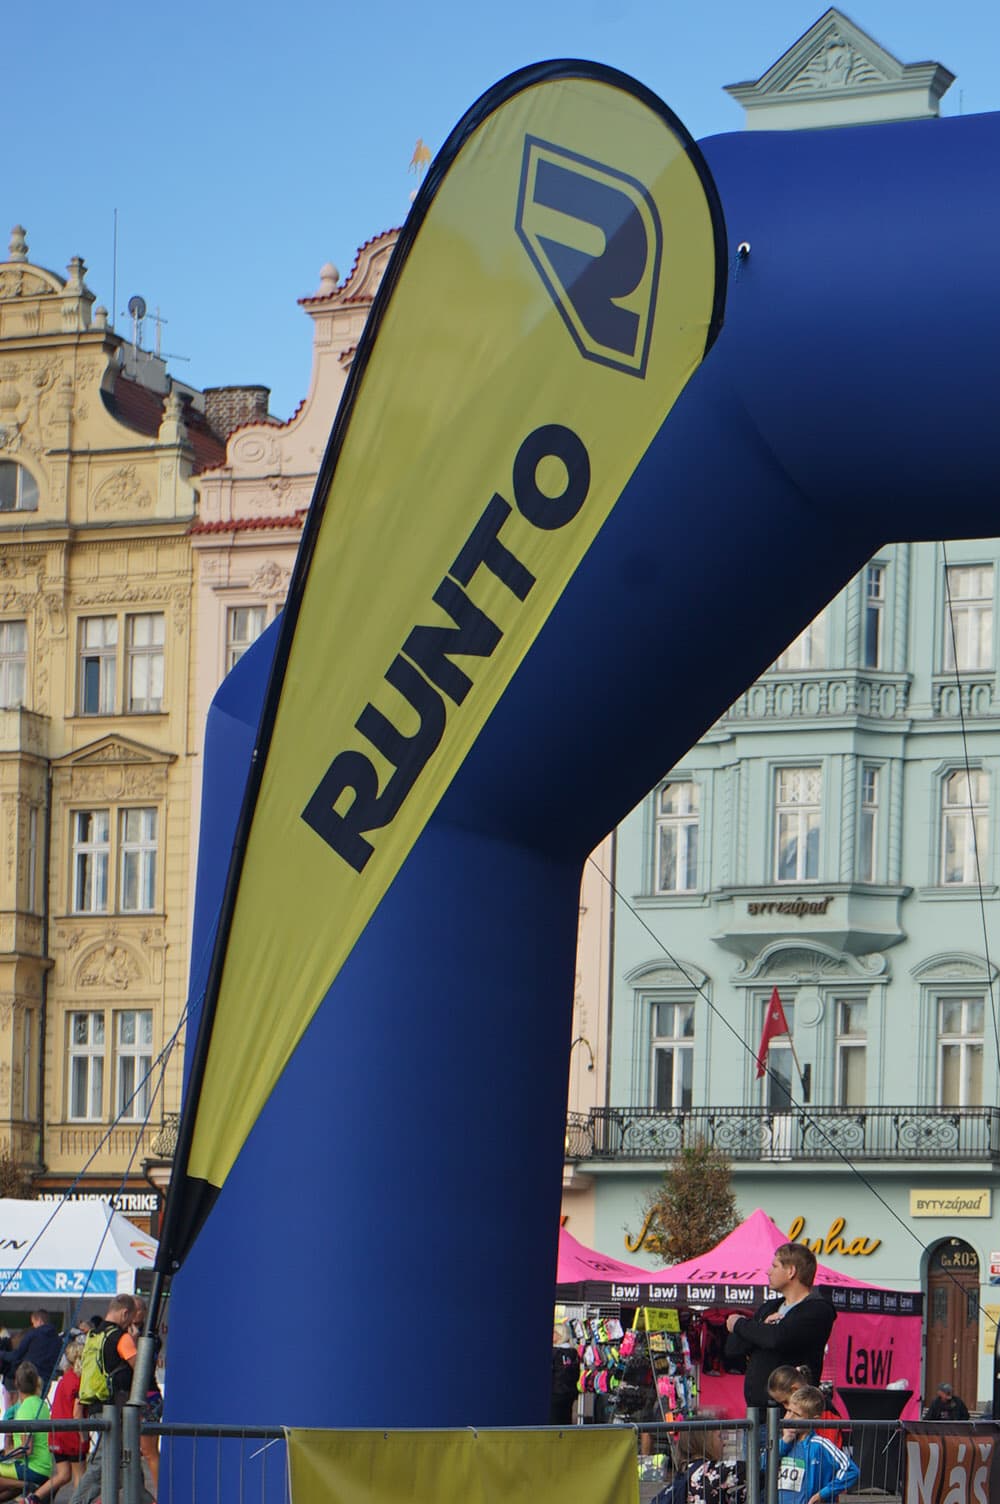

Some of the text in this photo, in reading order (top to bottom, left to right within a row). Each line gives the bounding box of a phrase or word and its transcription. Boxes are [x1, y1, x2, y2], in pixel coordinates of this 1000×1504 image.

[301, 423, 592, 874] RUNTO
[55, 1272, 85, 1290] R-Z
[611, 1284, 639, 1298] lawi
[649, 1284, 678, 1299] lawi
[686, 1285, 716, 1299] lawi
[725, 1286, 754, 1300] lawi
[845, 1335, 894, 1385] lawi
[778, 1468, 799, 1481] 40
